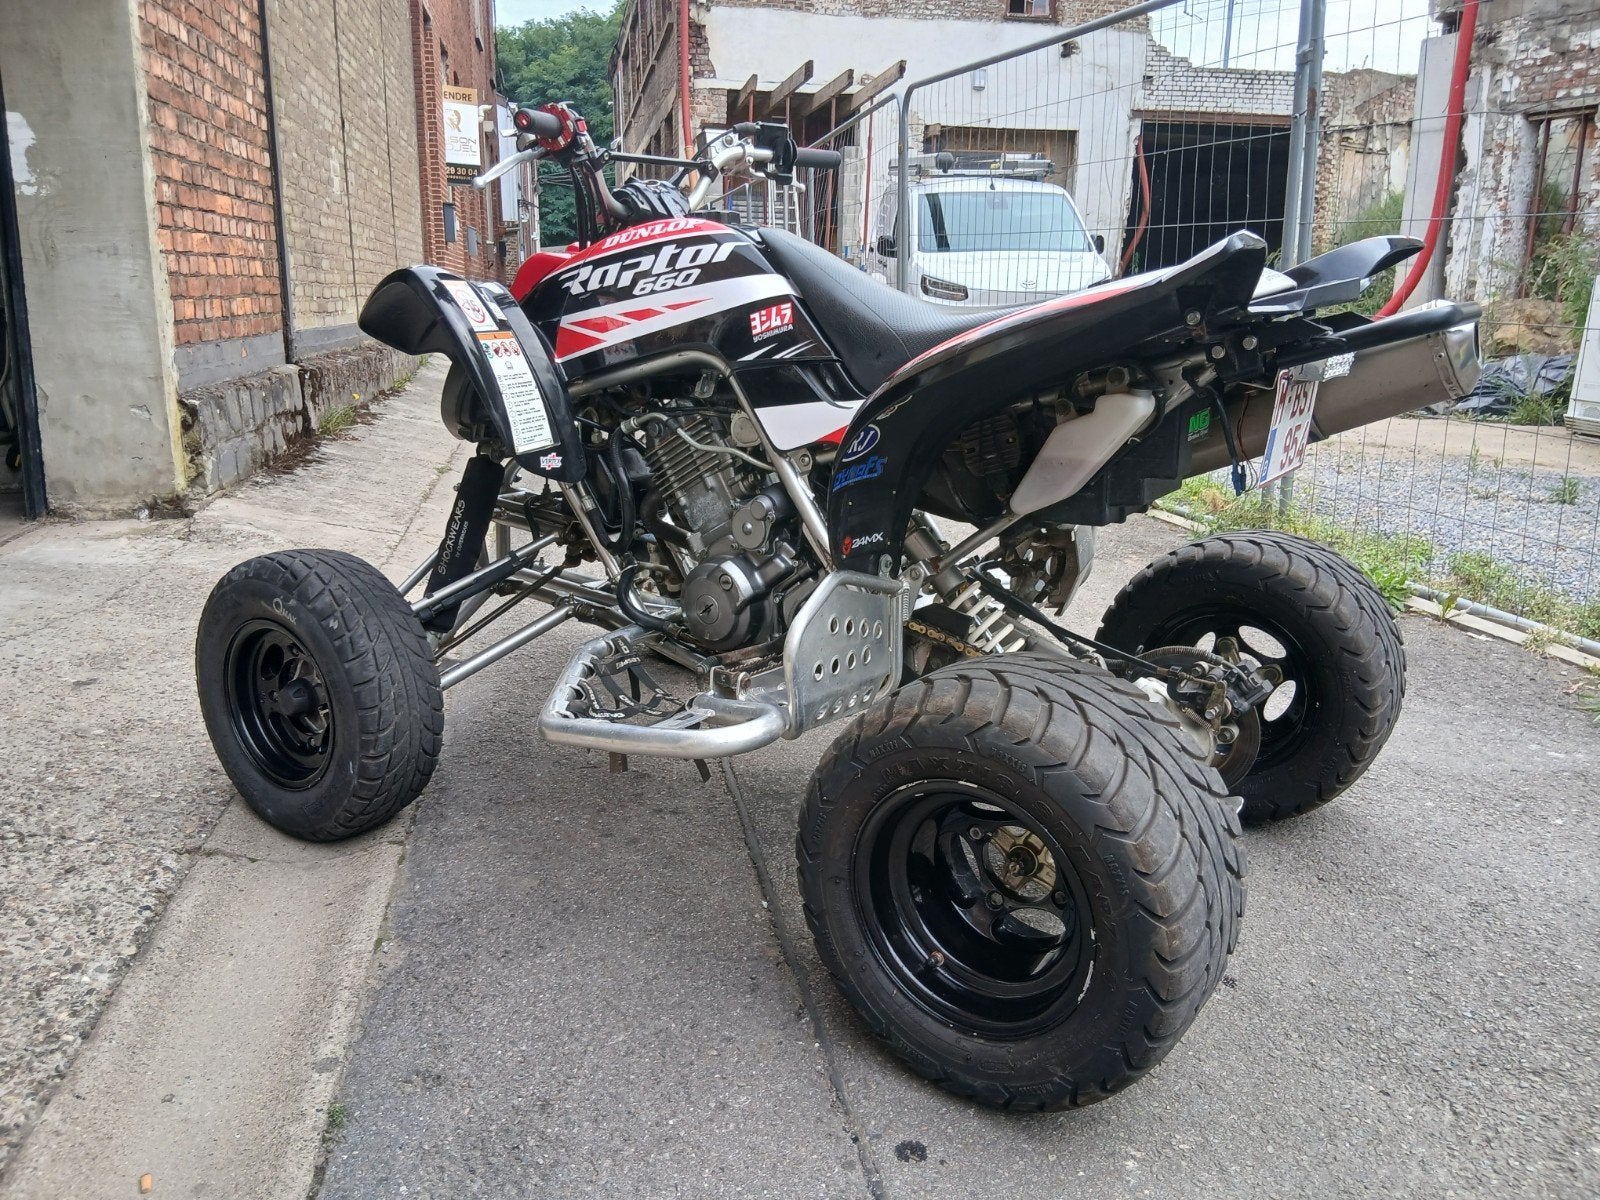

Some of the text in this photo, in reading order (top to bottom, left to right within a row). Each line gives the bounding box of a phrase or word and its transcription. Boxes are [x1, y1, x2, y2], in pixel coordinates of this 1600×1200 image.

[602, 218, 707, 249] DUNLOP
[632, 268, 702, 296] 660
[750, 303, 792, 336] ヨシムラ
[752, 323, 794, 343] YOSHIMURA
[1280, 420, 1309, 470] 954
[438, 499, 465, 575] SHOCKWEARS
[851, 531, 884, 549] 24MX
